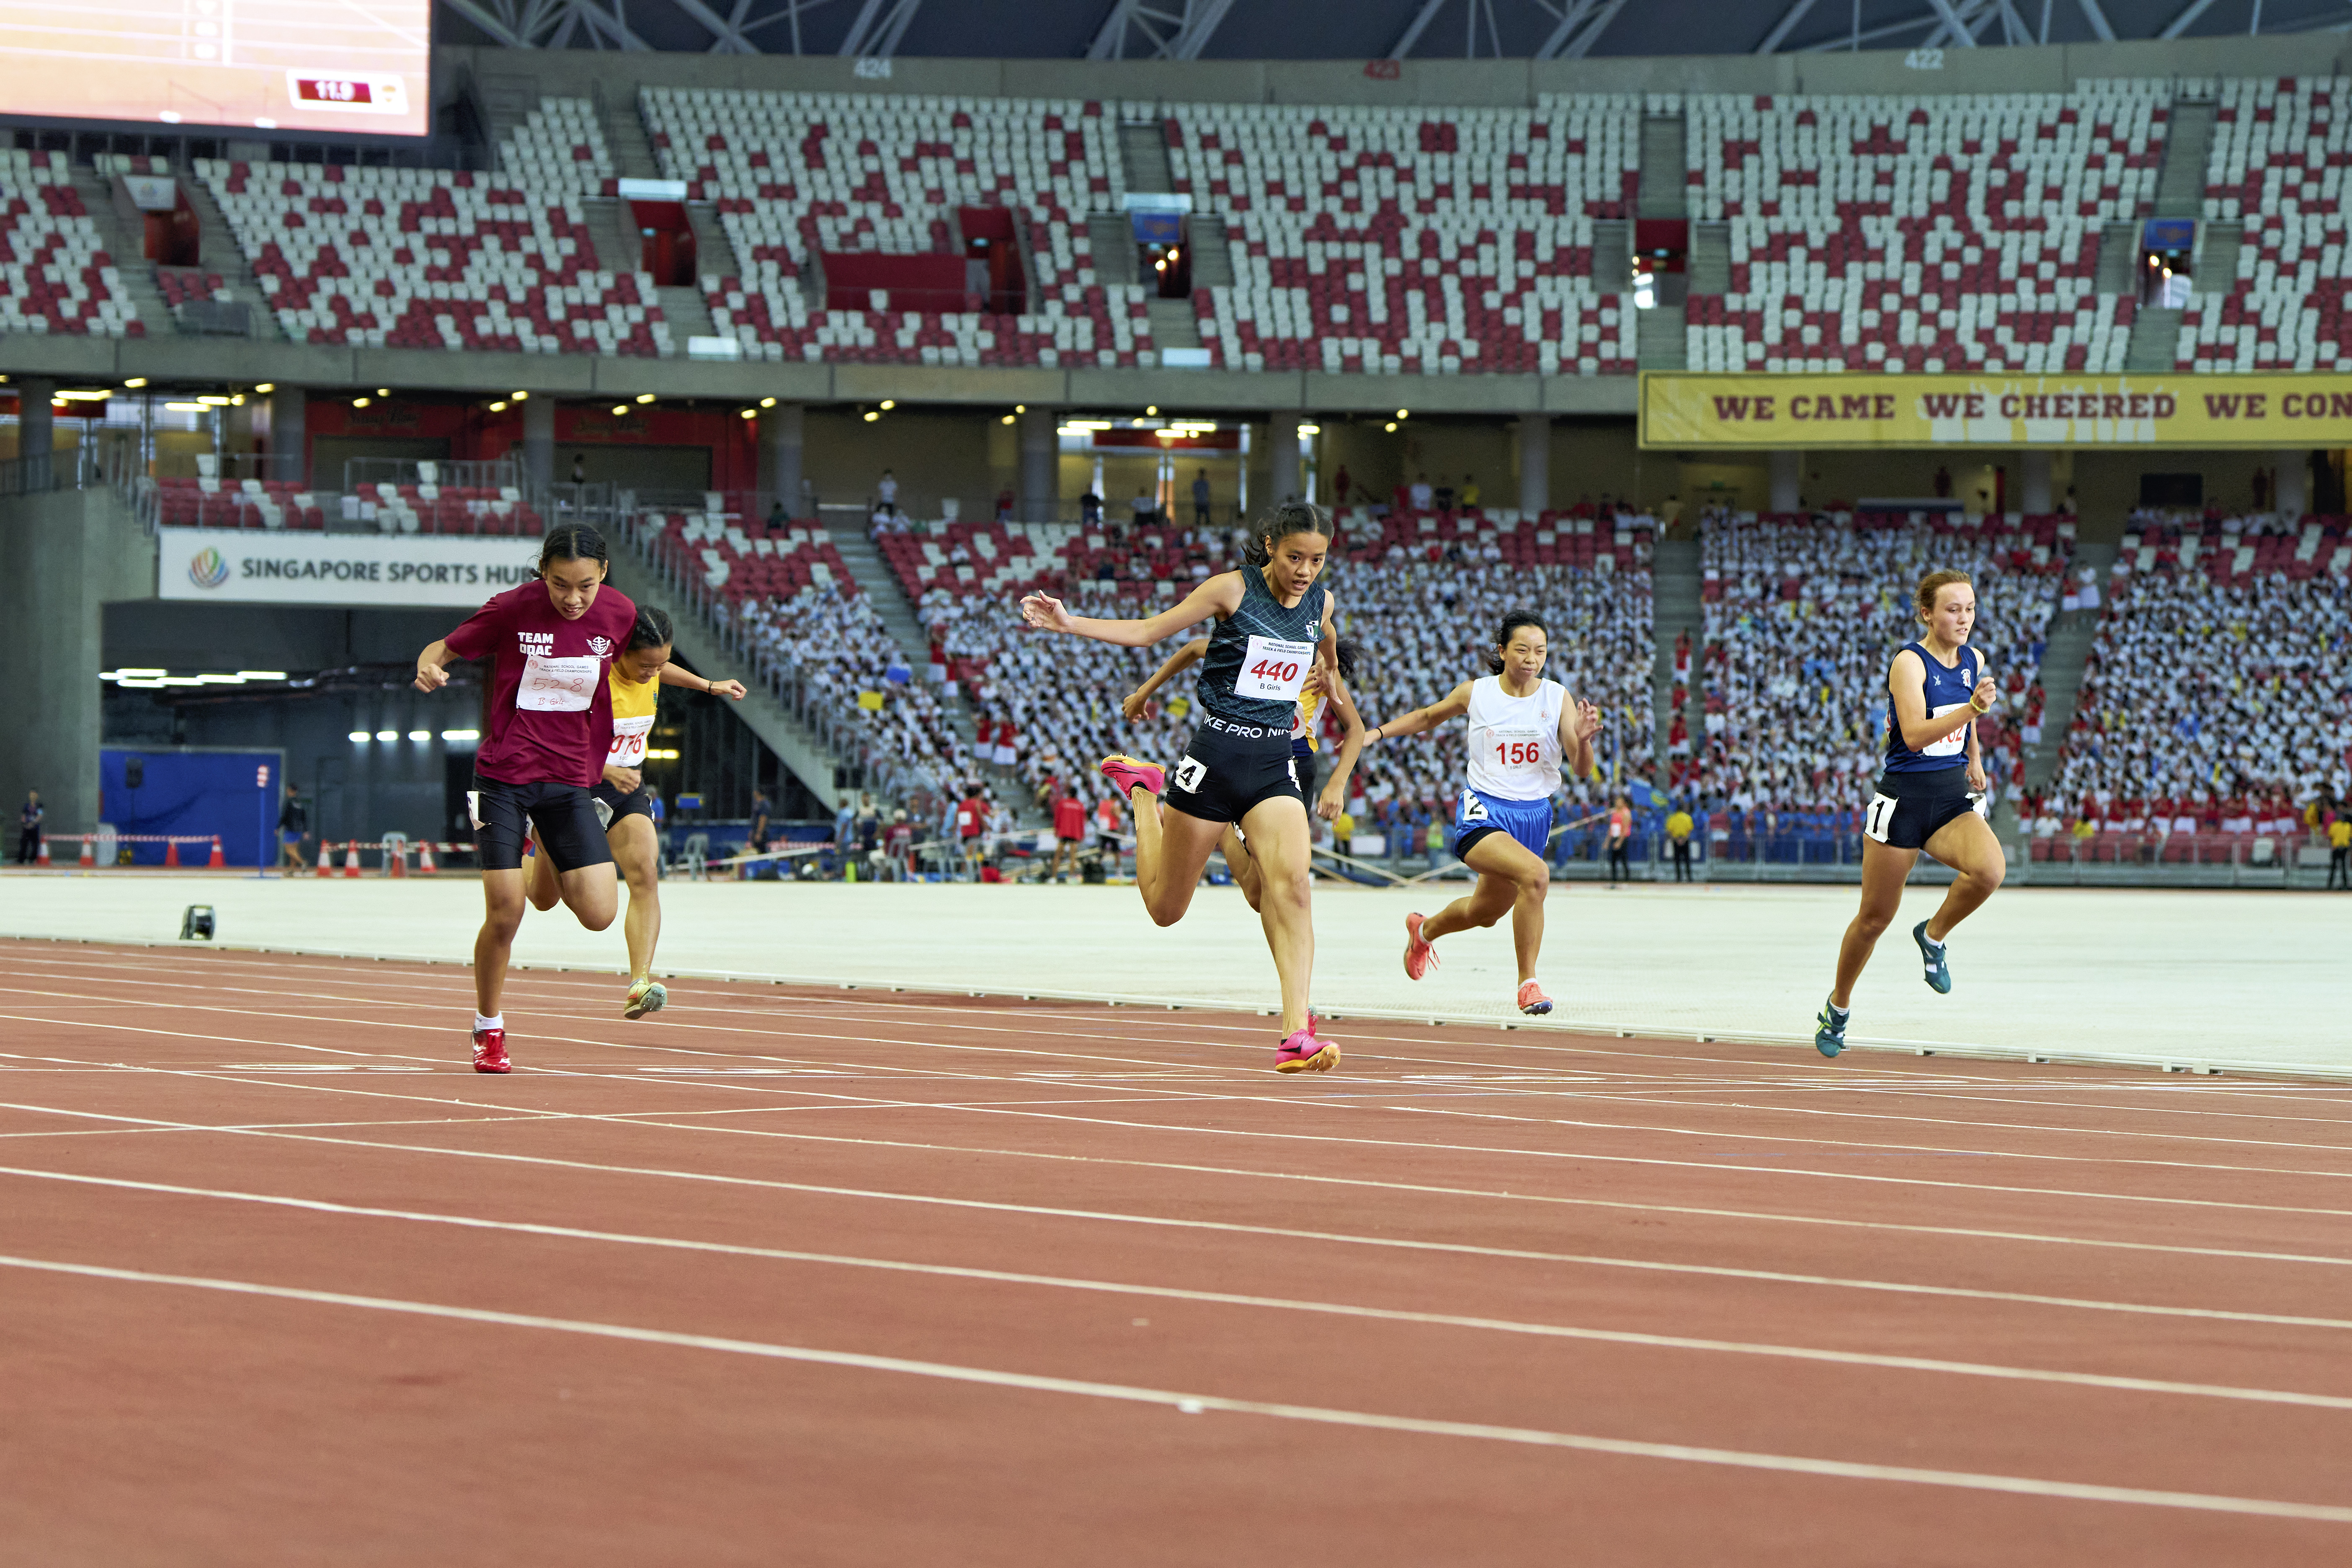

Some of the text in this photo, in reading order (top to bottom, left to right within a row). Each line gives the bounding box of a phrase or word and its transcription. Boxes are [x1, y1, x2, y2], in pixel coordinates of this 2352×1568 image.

[854, 59, 891, 78] 424
[1363, 59, 1400, 80] 423
[1905, 49, 1944, 69] 422
[1713, 394, 2352, 420] WE CAME WE CHEERED WE CON
[241, 558, 535, 585] SINGAPORE SPORTS HUB
[518, 632, 554, 644] TEAM
[519, 643, 552, 656] ODAC
[1250, 659, 1298, 682] 440
[531, 678, 584, 692] 528
[1225, 723, 1263, 738] PRO
[1496, 742, 1539, 765] 156
[1179, 765, 1197, 786] 4
[1469, 794, 1482, 815] 2
[1873, 801, 1885, 833] 1
